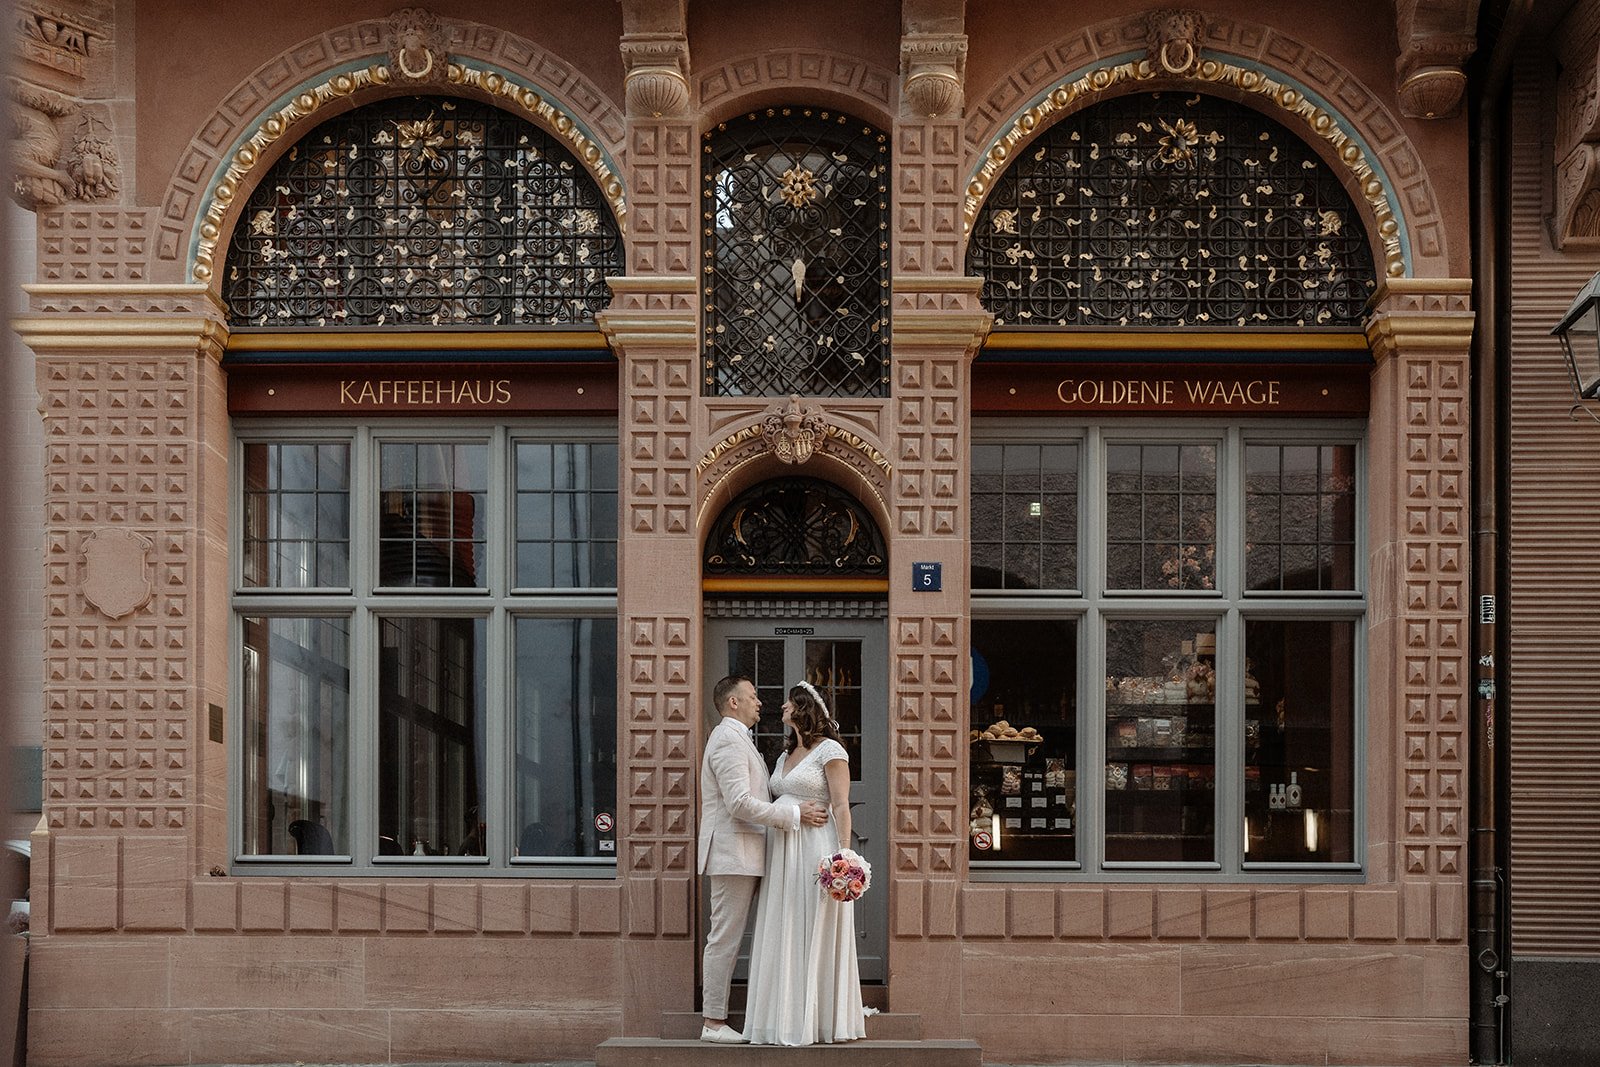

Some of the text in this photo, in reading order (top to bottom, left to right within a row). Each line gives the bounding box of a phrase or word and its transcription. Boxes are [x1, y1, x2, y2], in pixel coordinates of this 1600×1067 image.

[340, 380, 511, 404] KAFFEEHAUS
[1057, 379, 1280, 405] GOLDENE WAAGE
[923, 574, 932, 586] 5
